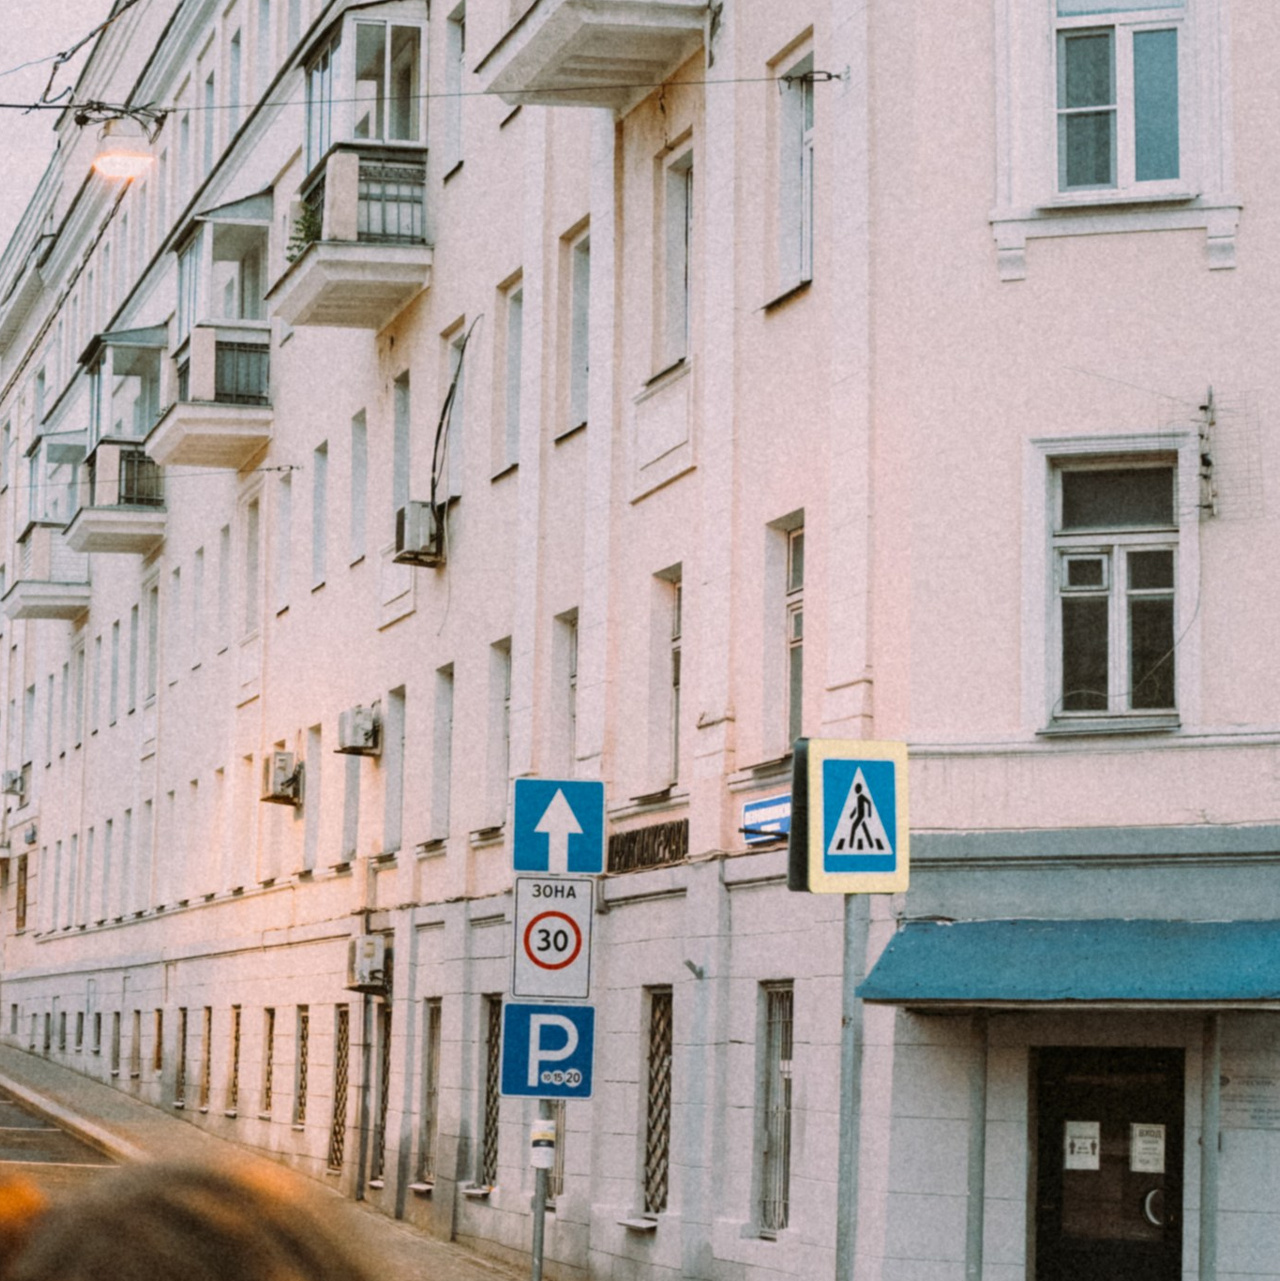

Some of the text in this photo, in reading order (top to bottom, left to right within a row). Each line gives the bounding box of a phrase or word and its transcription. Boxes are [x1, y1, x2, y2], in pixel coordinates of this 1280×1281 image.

[532, 884, 577, 899] ЗОНА
[537, 928, 569, 953] 30
[527, 1013, 579, 1087] P
[554, 1073, 563, 1082] 15
[566, 1072, 581, 1083] 20
